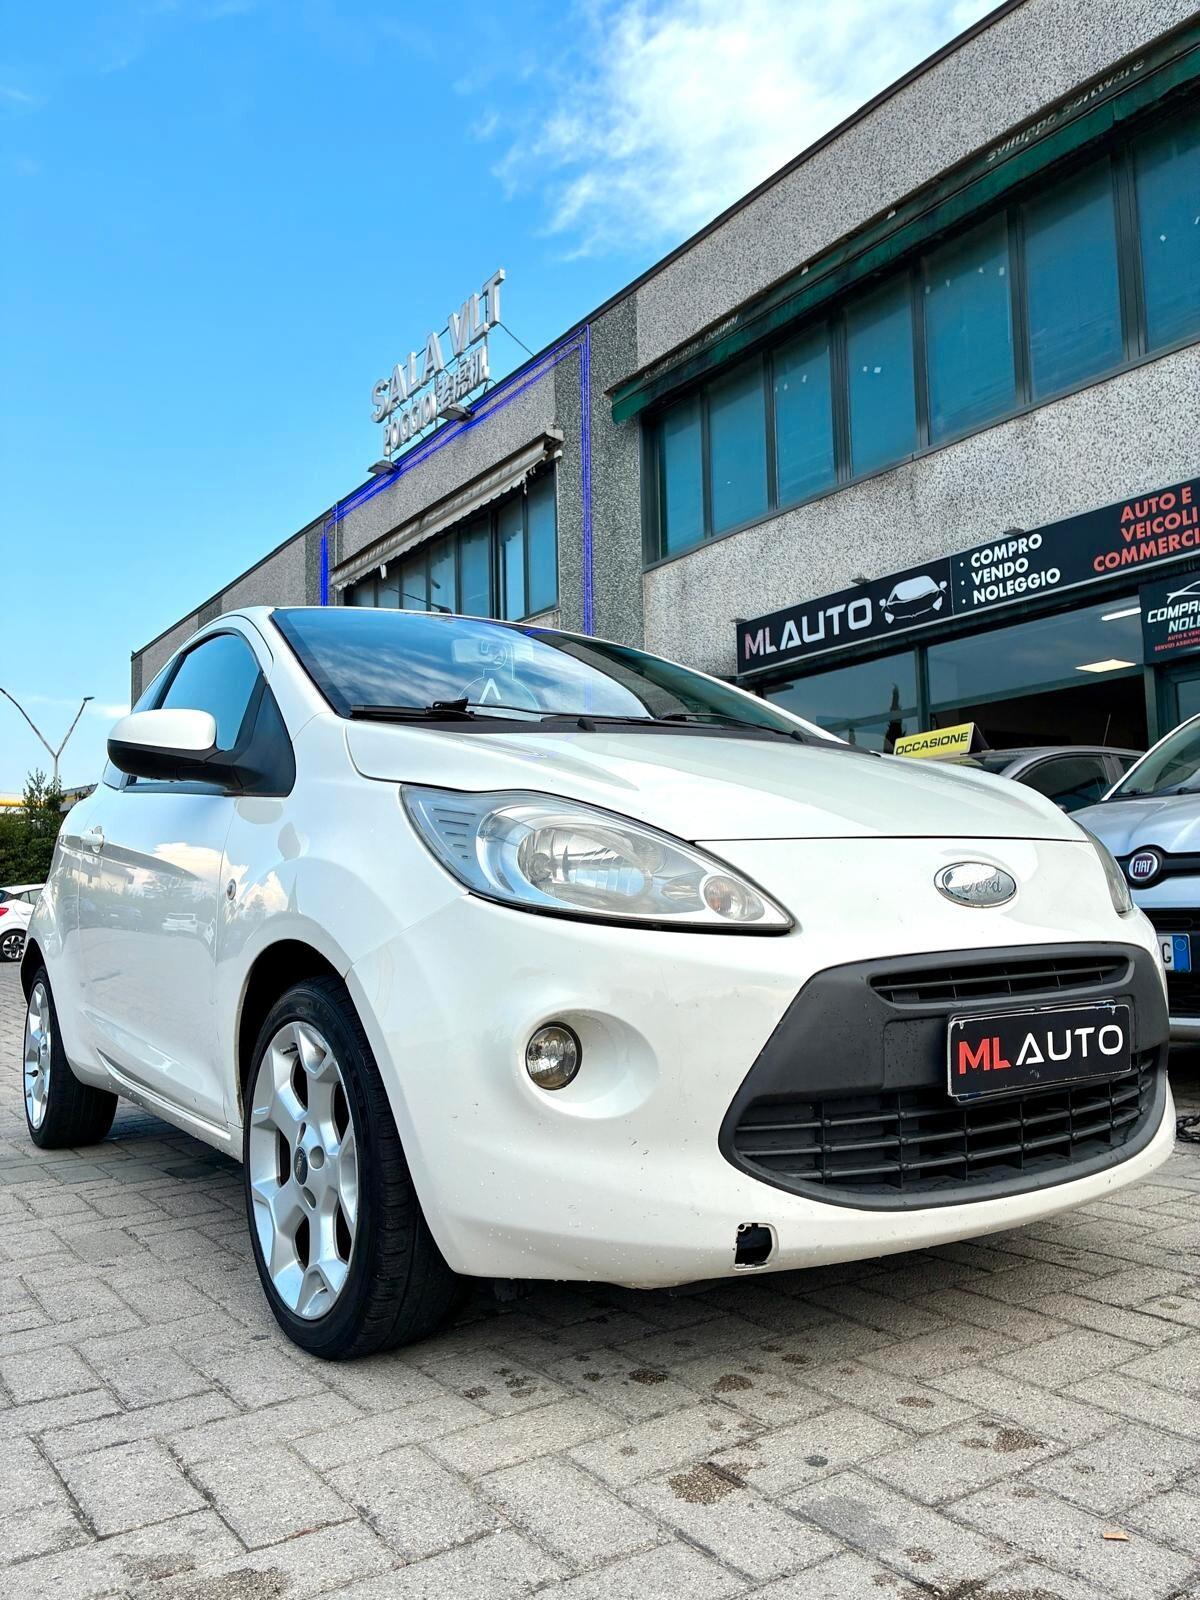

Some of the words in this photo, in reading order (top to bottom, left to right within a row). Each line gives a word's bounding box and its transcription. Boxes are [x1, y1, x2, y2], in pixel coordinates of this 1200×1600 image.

[371, 332, 445, 424] SALA
[448, 267, 506, 358] VLT
[383, 391, 437, 457] POGGIO
[1120, 493, 1176, 524] AUTO
[1181, 486, 1192, 505] E
[1121, 506, 1198, 543] VEICOLI
[970, 533, 1043, 568] COMPRO
[971, 557, 1029, 586] VENDO
[973, 567, 1061, 605] NOLEGGIO
[744, 626, 778, 660] ML
[779, 597, 873, 651] AUTO
[1147, 600, 1200, 624] COMPR
[894, 731, 970, 755] OCCASIONE
[1134, 859, 1152, 873] FIAT
[958, 1037, 1012, 1076] ML
[1015, 1023, 1124, 1067] AUTO
